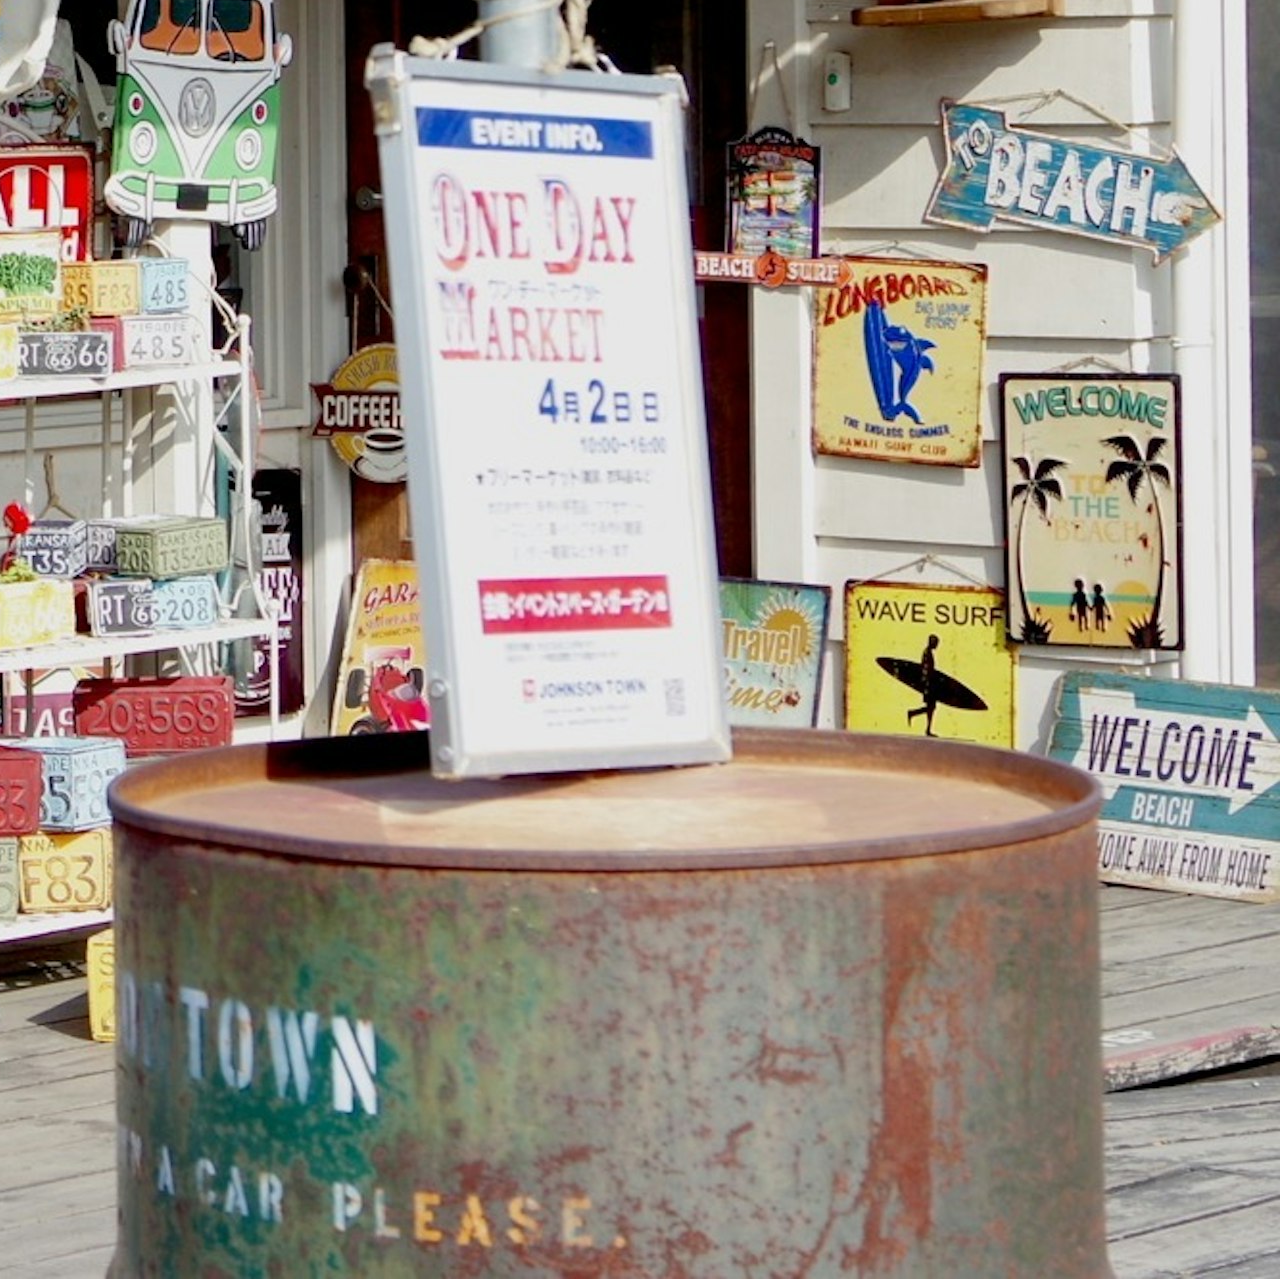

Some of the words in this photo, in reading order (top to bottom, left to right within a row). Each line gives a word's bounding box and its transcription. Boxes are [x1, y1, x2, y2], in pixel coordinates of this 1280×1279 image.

[470, 118, 541, 150] EVENT
[546, 123, 603, 152] INFO.
[986, 131, 1154, 240] BEACH
[695, 256, 756, 278] BEACH
[786, 262, 840, 282] SURF
[150, 278, 188, 306] 485
[824, 272, 969, 328] LONGBOARD
[19, 343, 41, 368] RT
[78, 343, 109, 368] 66
[130, 335, 186, 361] 485
[1012, 383, 1169, 429] WELCOME
[843, 415, 860, 430] THE
[865, 422, 906, 439] ENDLESS
[909, 423, 951, 439] SUMMER
[1068, 474, 1111, 495] TO
[1067, 495, 1122, 520] THE
[1052, 518, 1142, 547] BEACH
[100, 593, 126, 627] RT
[856, 597, 927, 625] WAVE
[720, 621, 803, 666] Travel
[539, 680, 603, 699] JOHNSON
[605, 678, 648, 695] TOWN
[1087, 713, 1265, 792] WELCOME
[1130, 791, 1195, 829] BEACH
[23, 855, 99, 905] F83
[1136, 839, 1178, 879] AWAY
[1180, 844, 1223, 886] FROM
[1224, 847, 1271, 891] HOME
[194, 1157, 283, 1225] CAR
[332, 1180, 628, 1249] PLEASE.
